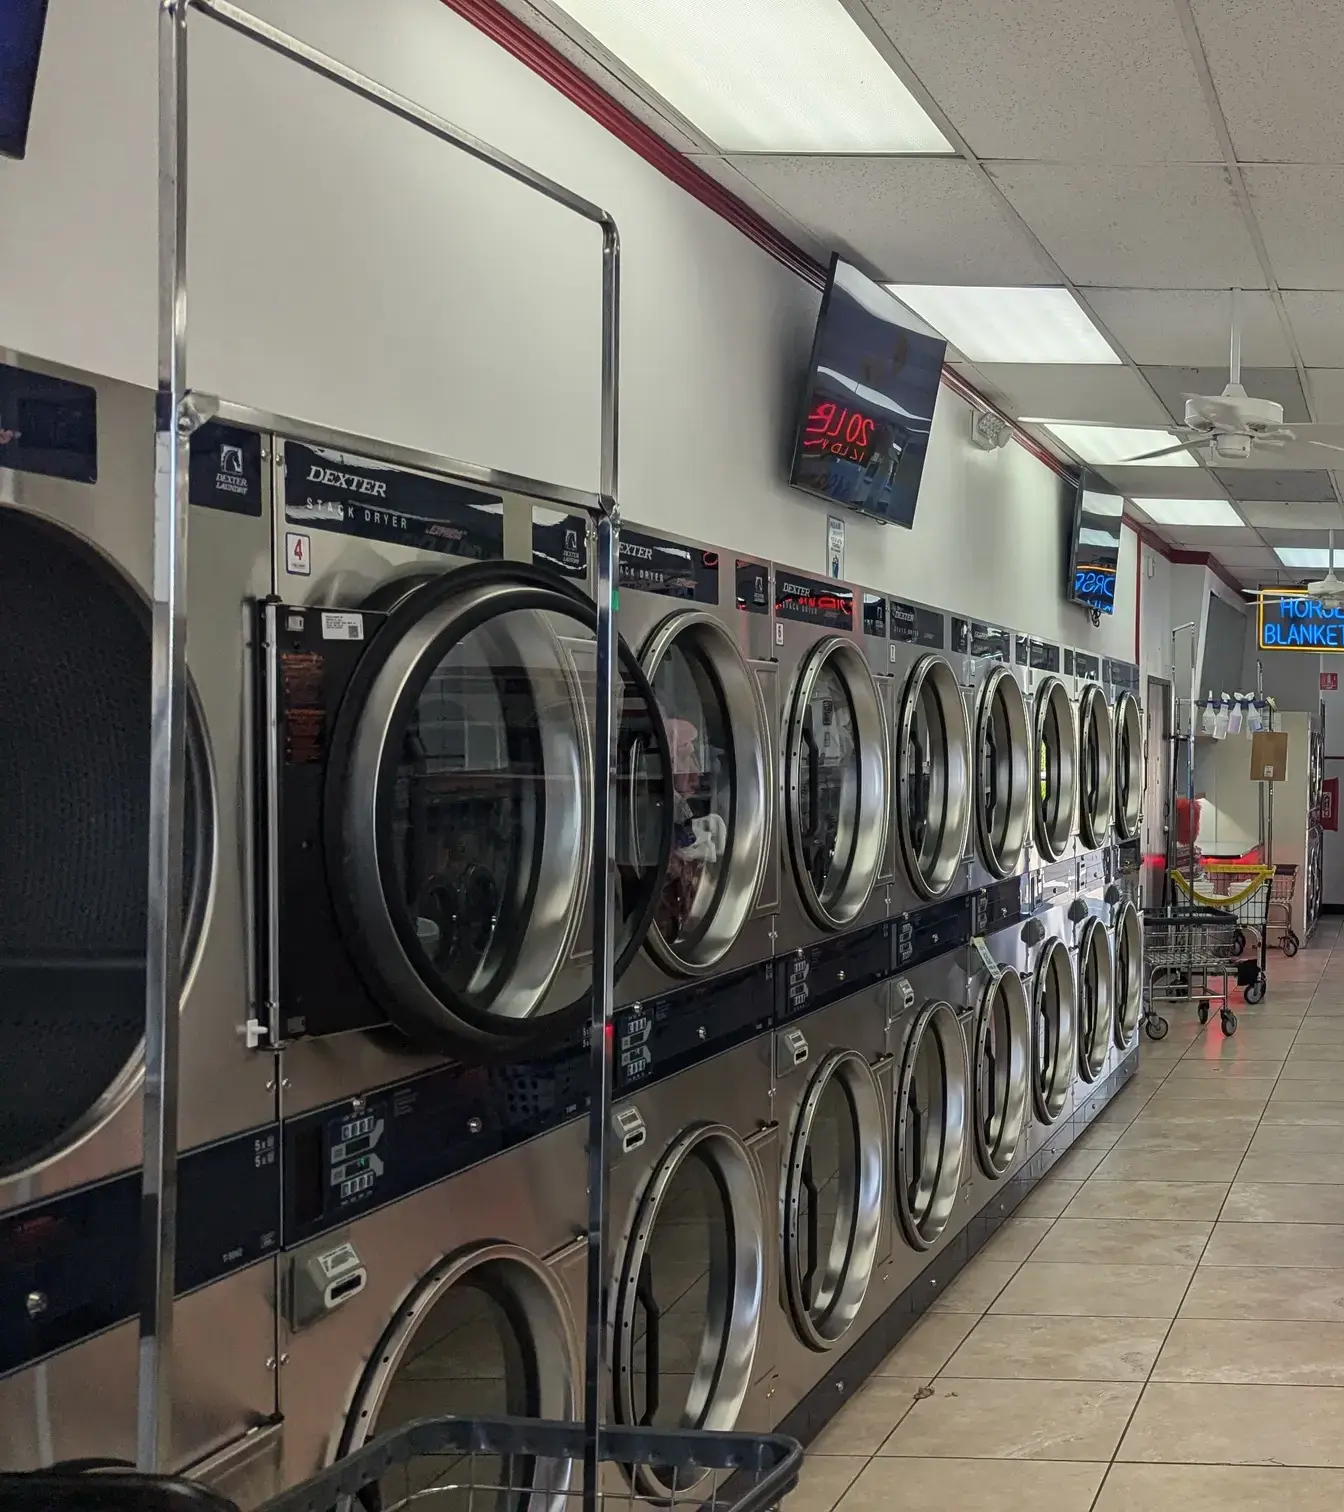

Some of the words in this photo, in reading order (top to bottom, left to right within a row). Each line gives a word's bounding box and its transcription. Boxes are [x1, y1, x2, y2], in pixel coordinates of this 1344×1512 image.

[215, 473, 248, 488] DEXTER
[215, 482, 248, 496] LAUNDRY
[307, 465, 388, 498] DEXTER
[306, 497, 356, 519] STACK
[364, 510, 409, 530] DRYER
[293, 538, 303, 561] 4
[618, 541, 653, 561] EXTER
[619, 564, 635, 578] ACK
[639, 569, 664, 583] DRYER
[782, 582, 811, 598] DEXTER
[894, 609, 915, 623] DEXTER
